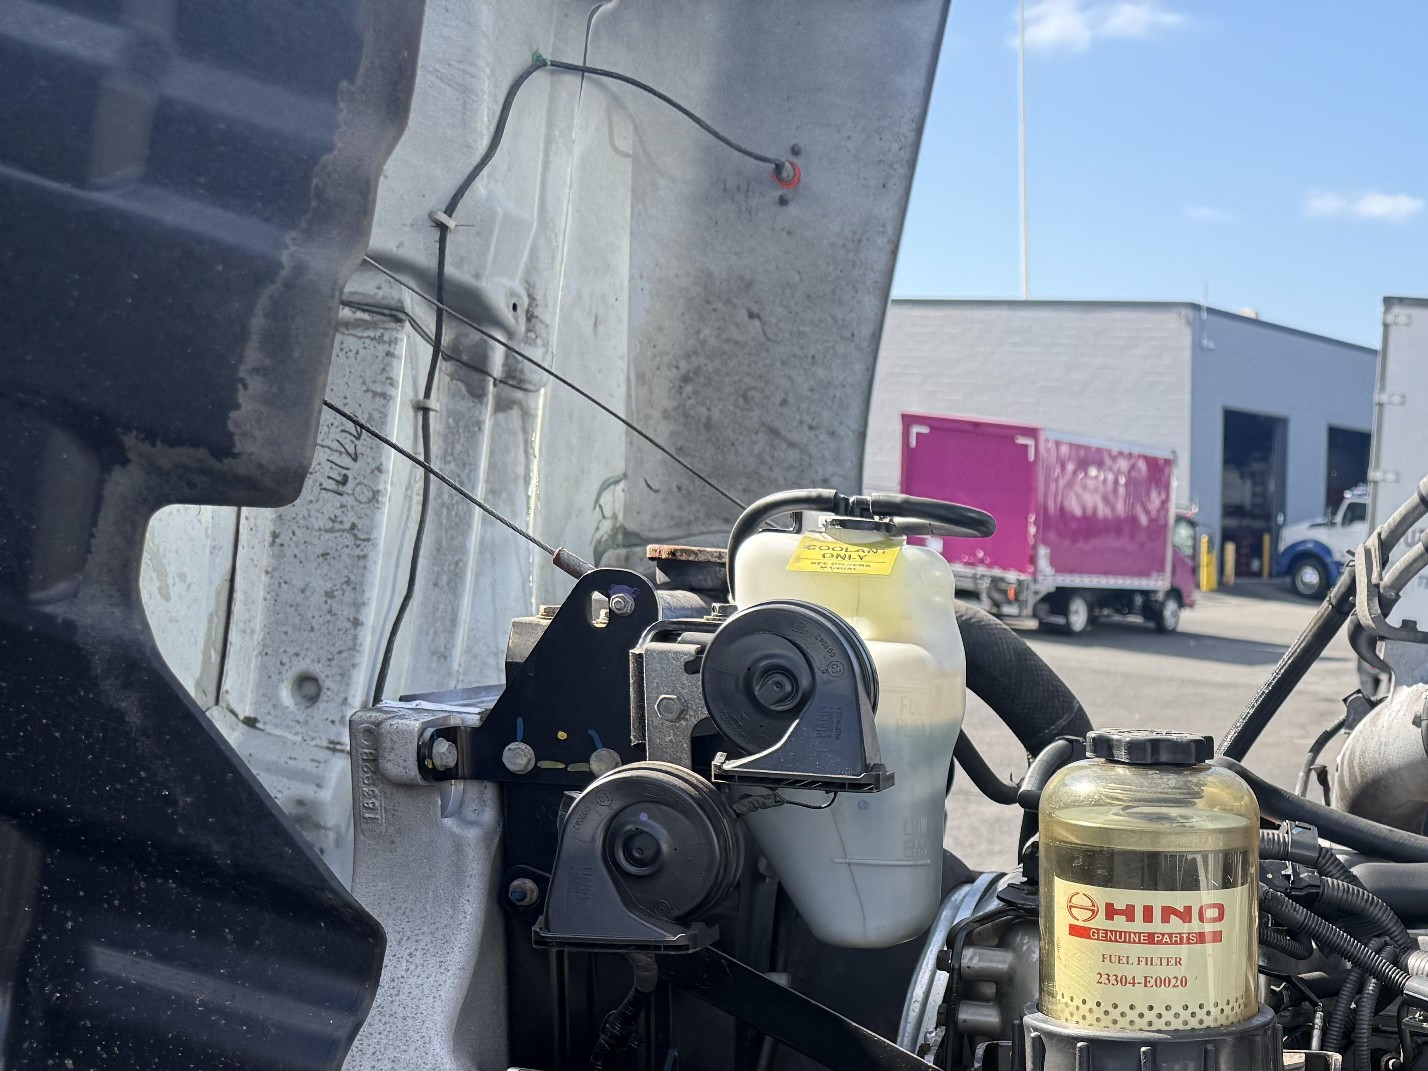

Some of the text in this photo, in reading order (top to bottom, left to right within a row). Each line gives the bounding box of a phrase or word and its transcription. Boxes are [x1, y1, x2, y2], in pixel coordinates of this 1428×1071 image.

[803, 544, 888, 556] COOLANT
[821, 553, 867, 561] ONLY
[1104, 902, 1226, 925] HINO
[1089, 928, 1198, 944] GENUINE PARTS
[1100, 952, 1184, 967] FUEL FILTER
[1096, 971, 1189, 988] 23304-E0020
